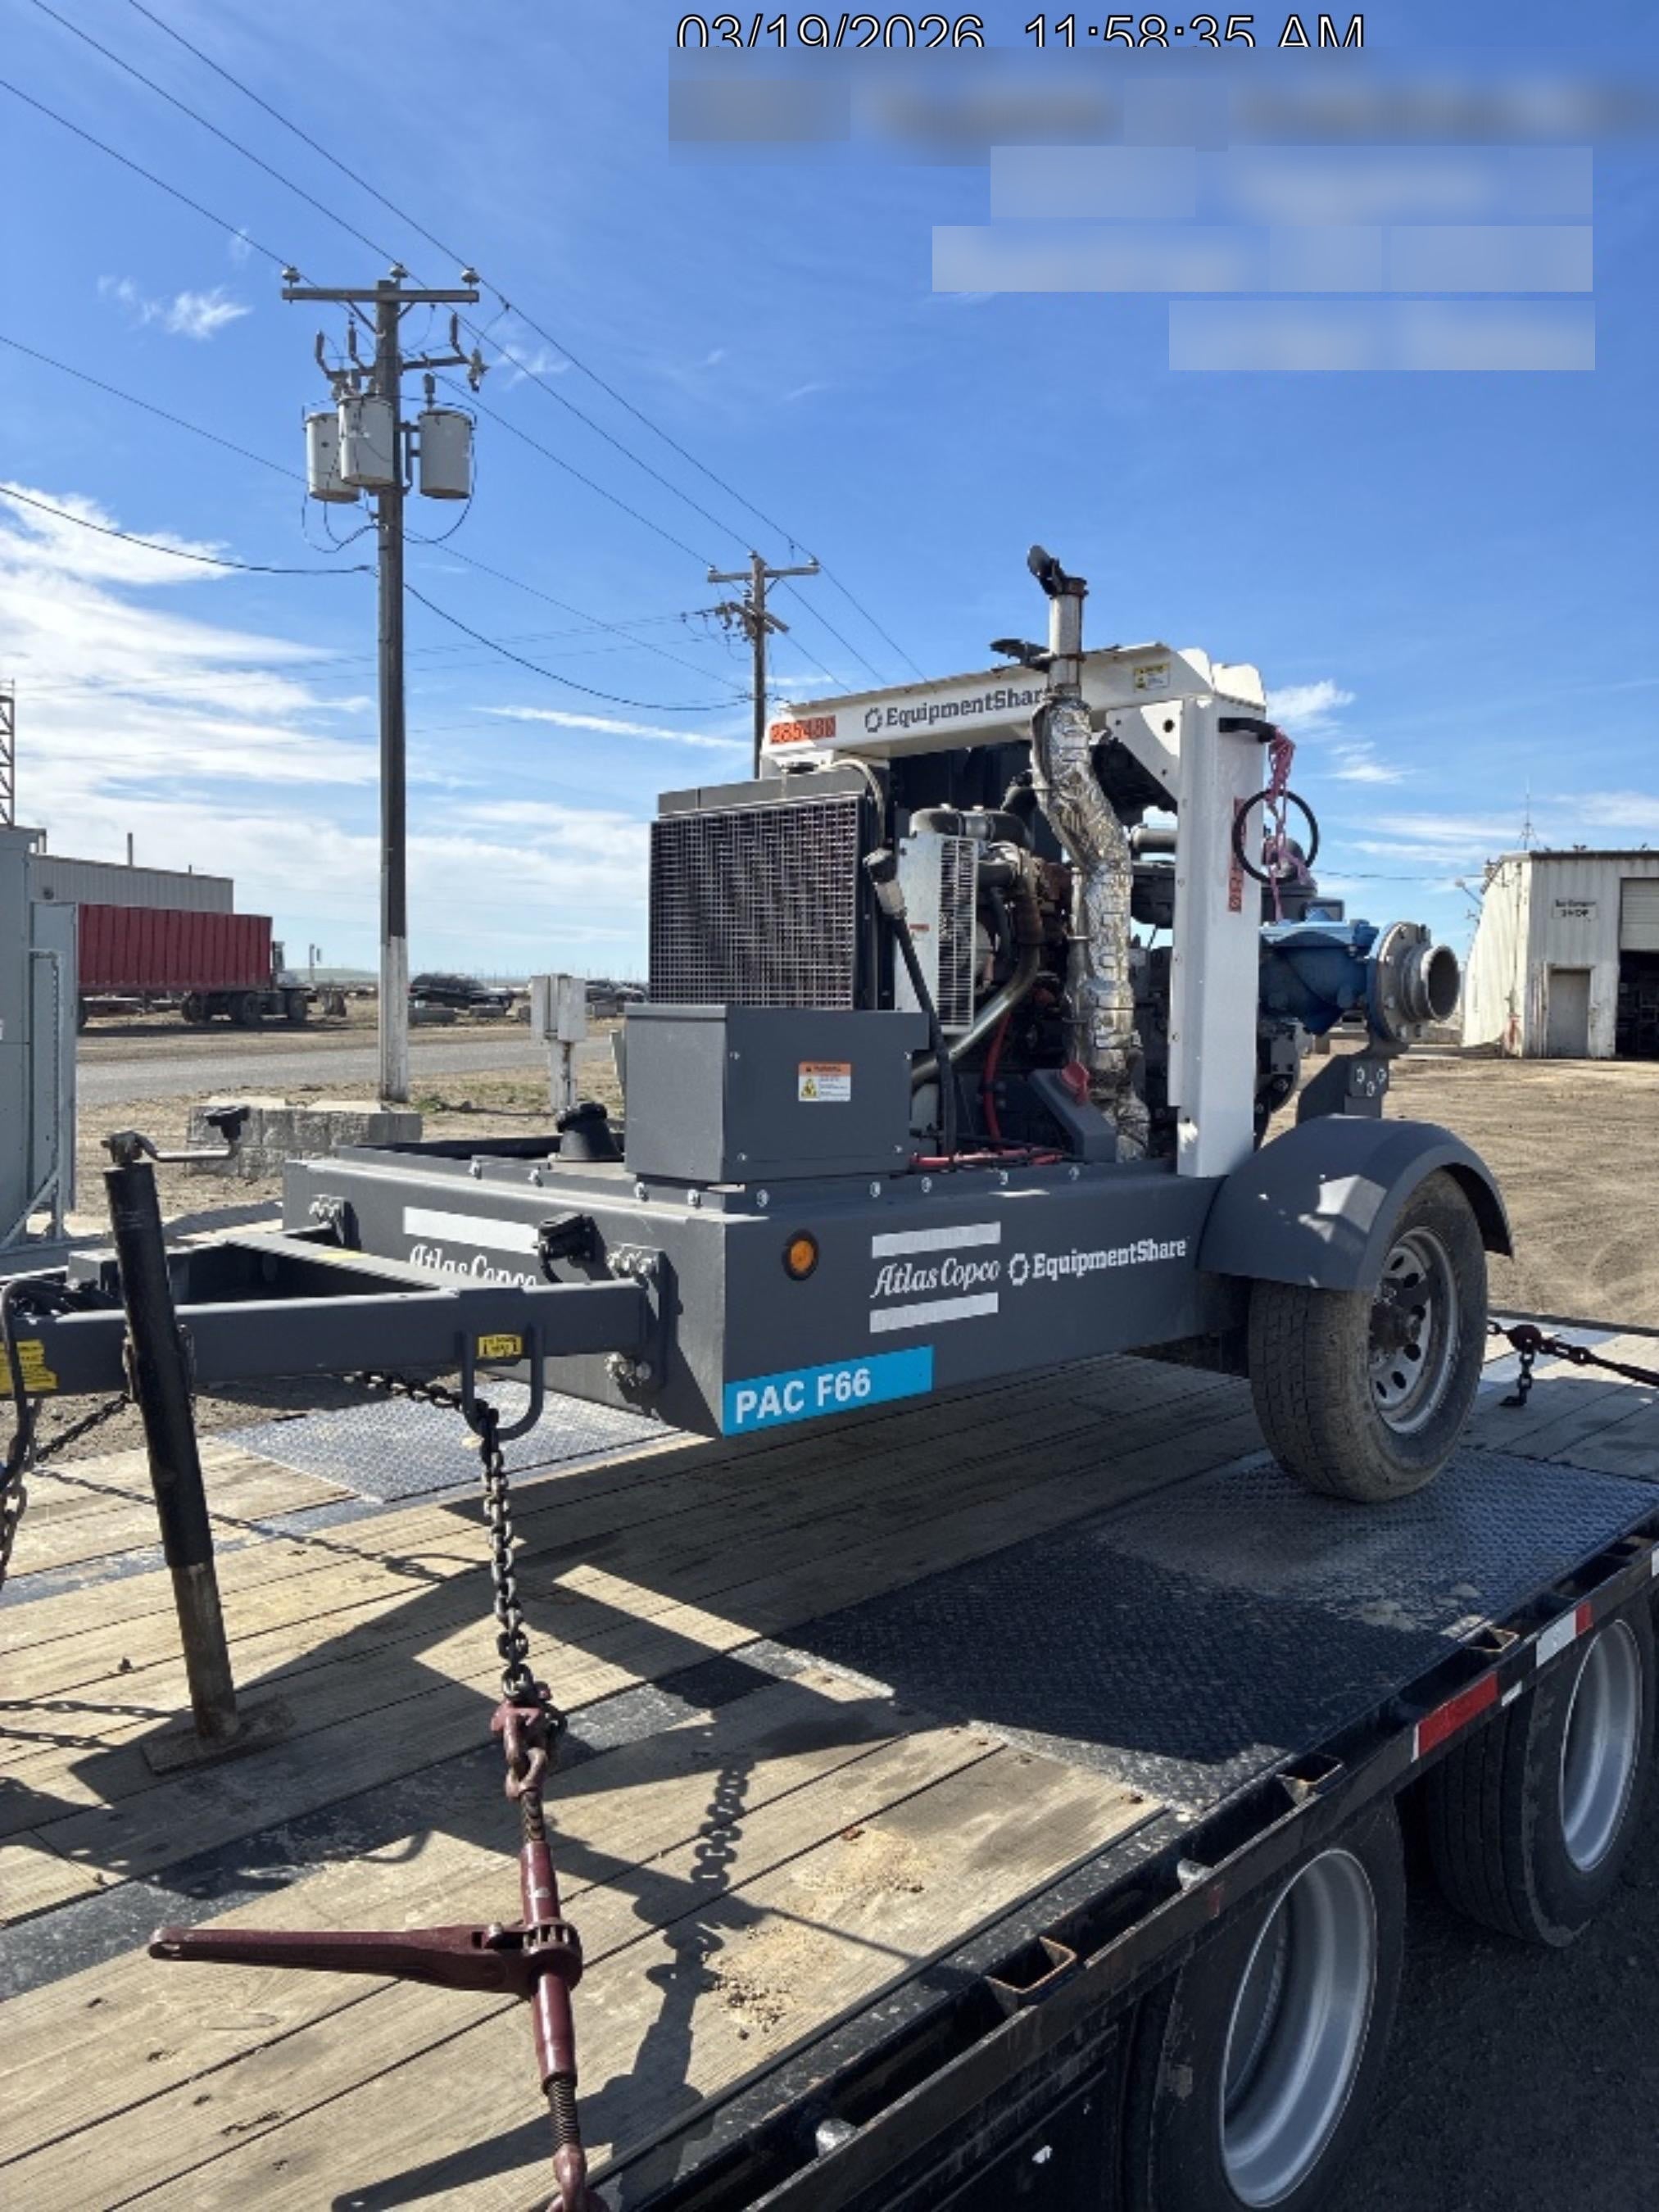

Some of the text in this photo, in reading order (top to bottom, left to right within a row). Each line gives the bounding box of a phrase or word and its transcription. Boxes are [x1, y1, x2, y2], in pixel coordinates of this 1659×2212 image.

[886, 687, 1047, 728] EquipmentShar
[870, 1258, 1001, 1298] Atlas Copco
[1031, 1239, 1186, 1281] EquipmentShare
[736, 1367, 872, 1424] PAC F66
